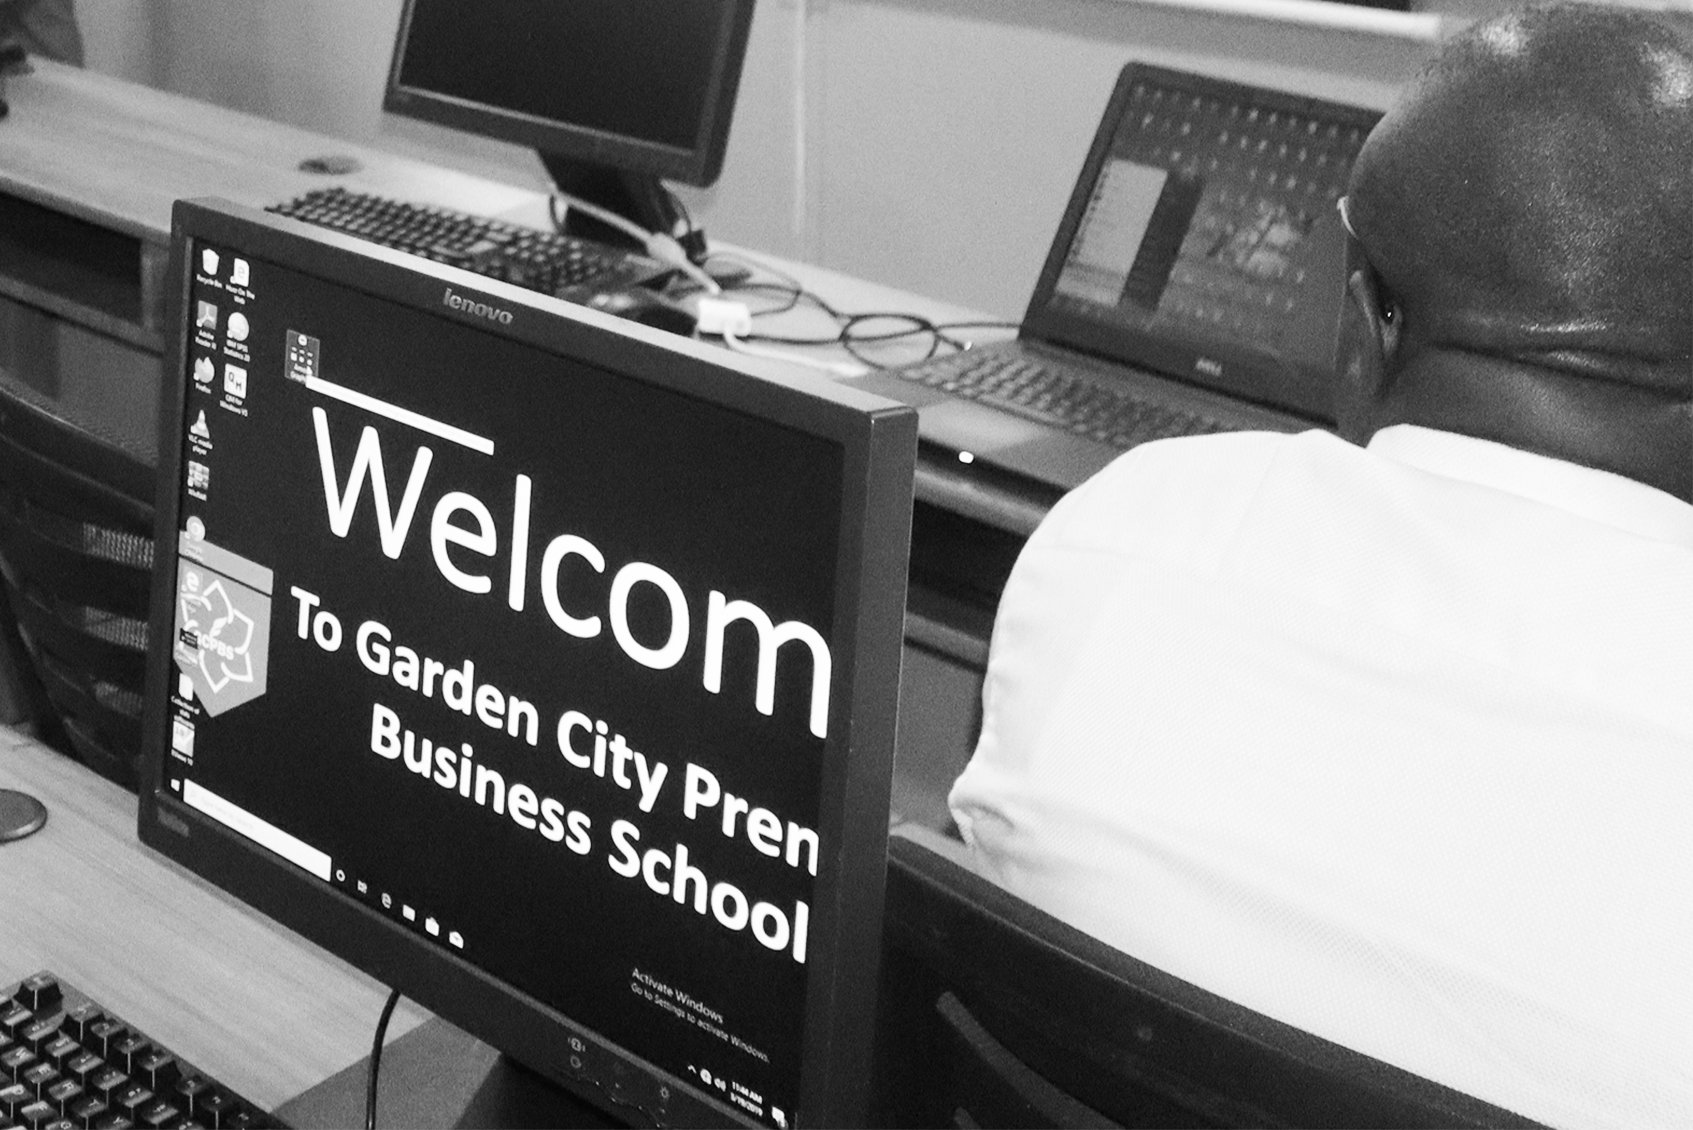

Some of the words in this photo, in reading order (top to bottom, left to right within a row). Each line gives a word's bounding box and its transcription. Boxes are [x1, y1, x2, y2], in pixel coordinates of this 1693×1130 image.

[443, 287, 513, 324] lenovo
[312, 406, 832, 739] Welcom
[290, 585, 343, 652] To
[356, 620, 539, 746] Garden
[557, 710, 669, 813] City
[370, 702, 593, 856] Business
[608, 819, 809, 964] School
[631, 982, 643, 996] Go
[644, 989, 653, 1001] to
[654, 994, 685, 1019] Settings
[687, 1013, 696, 1024] to
[697, 1019, 729, 1042] activate
[632, 968, 674, 997] Activate
[675, 989, 724, 1024] Windows
